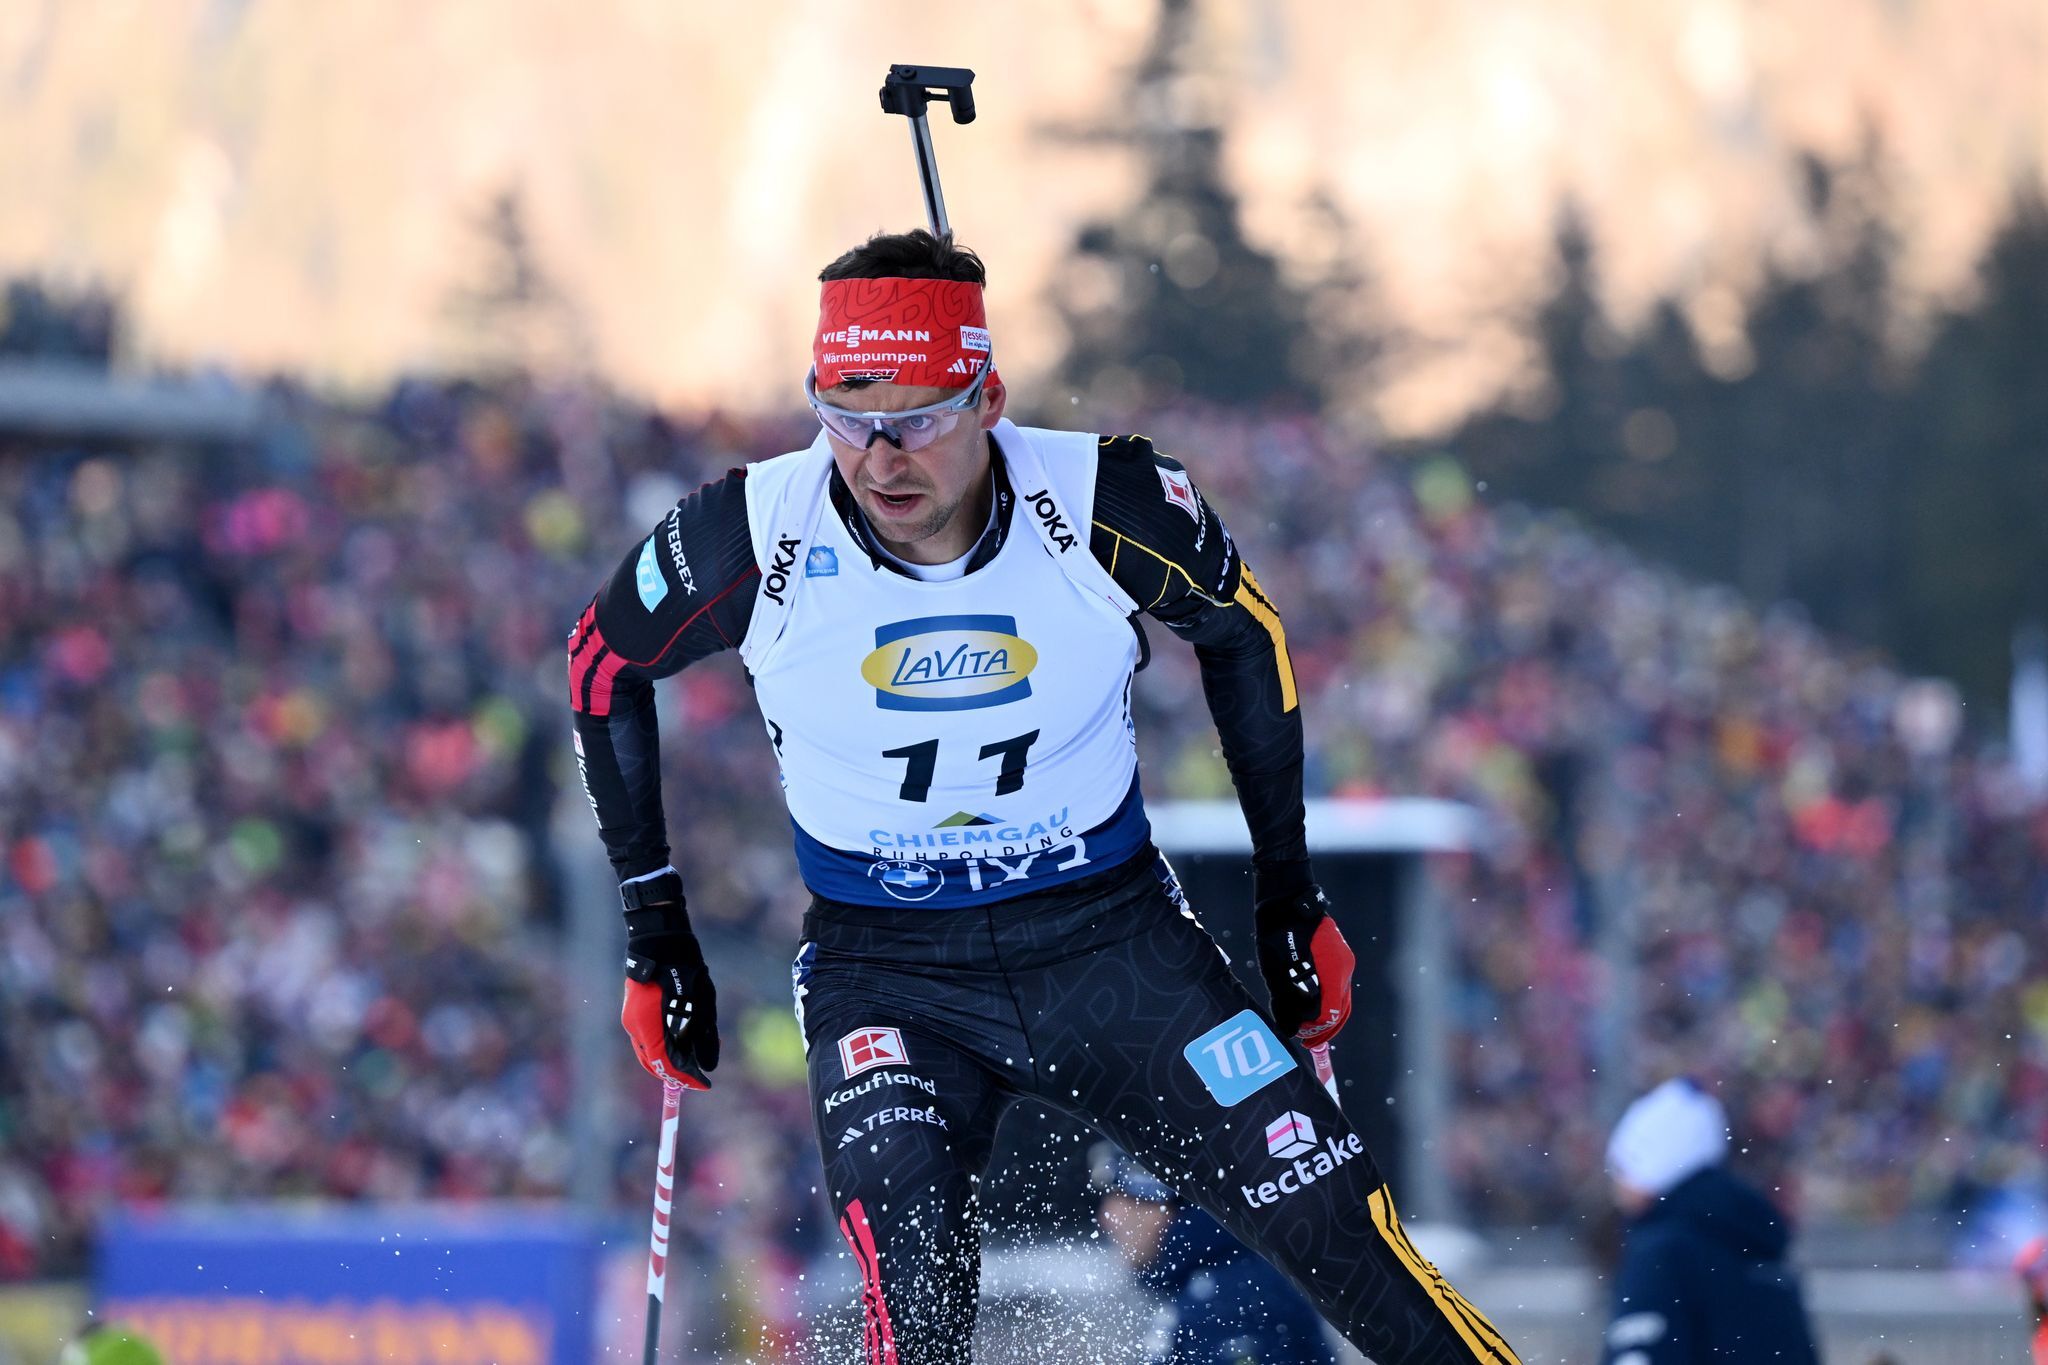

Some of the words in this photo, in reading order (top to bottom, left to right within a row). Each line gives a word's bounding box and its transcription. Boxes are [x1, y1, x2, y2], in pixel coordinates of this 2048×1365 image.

[822, 325, 930, 348] VIESSMANN
[822, 352, 927, 365] Wärmepumpen
[1024, 489, 1074, 554] JOKA
[668, 517, 698, 596] TERREX
[763, 539, 802, 606] JOKA
[882, 728, 1041, 803] 11
[869, 806, 1069, 848] CHIEMGAU
[873, 826, 1073, 861] RUHPOLDING
[1202, 1026, 1284, 1079] TQ
[824, 1071, 937, 1114] Kaufland
[862, 1107, 948, 1131] TERREX
[1241, 1132, 1364, 1209] tectake
